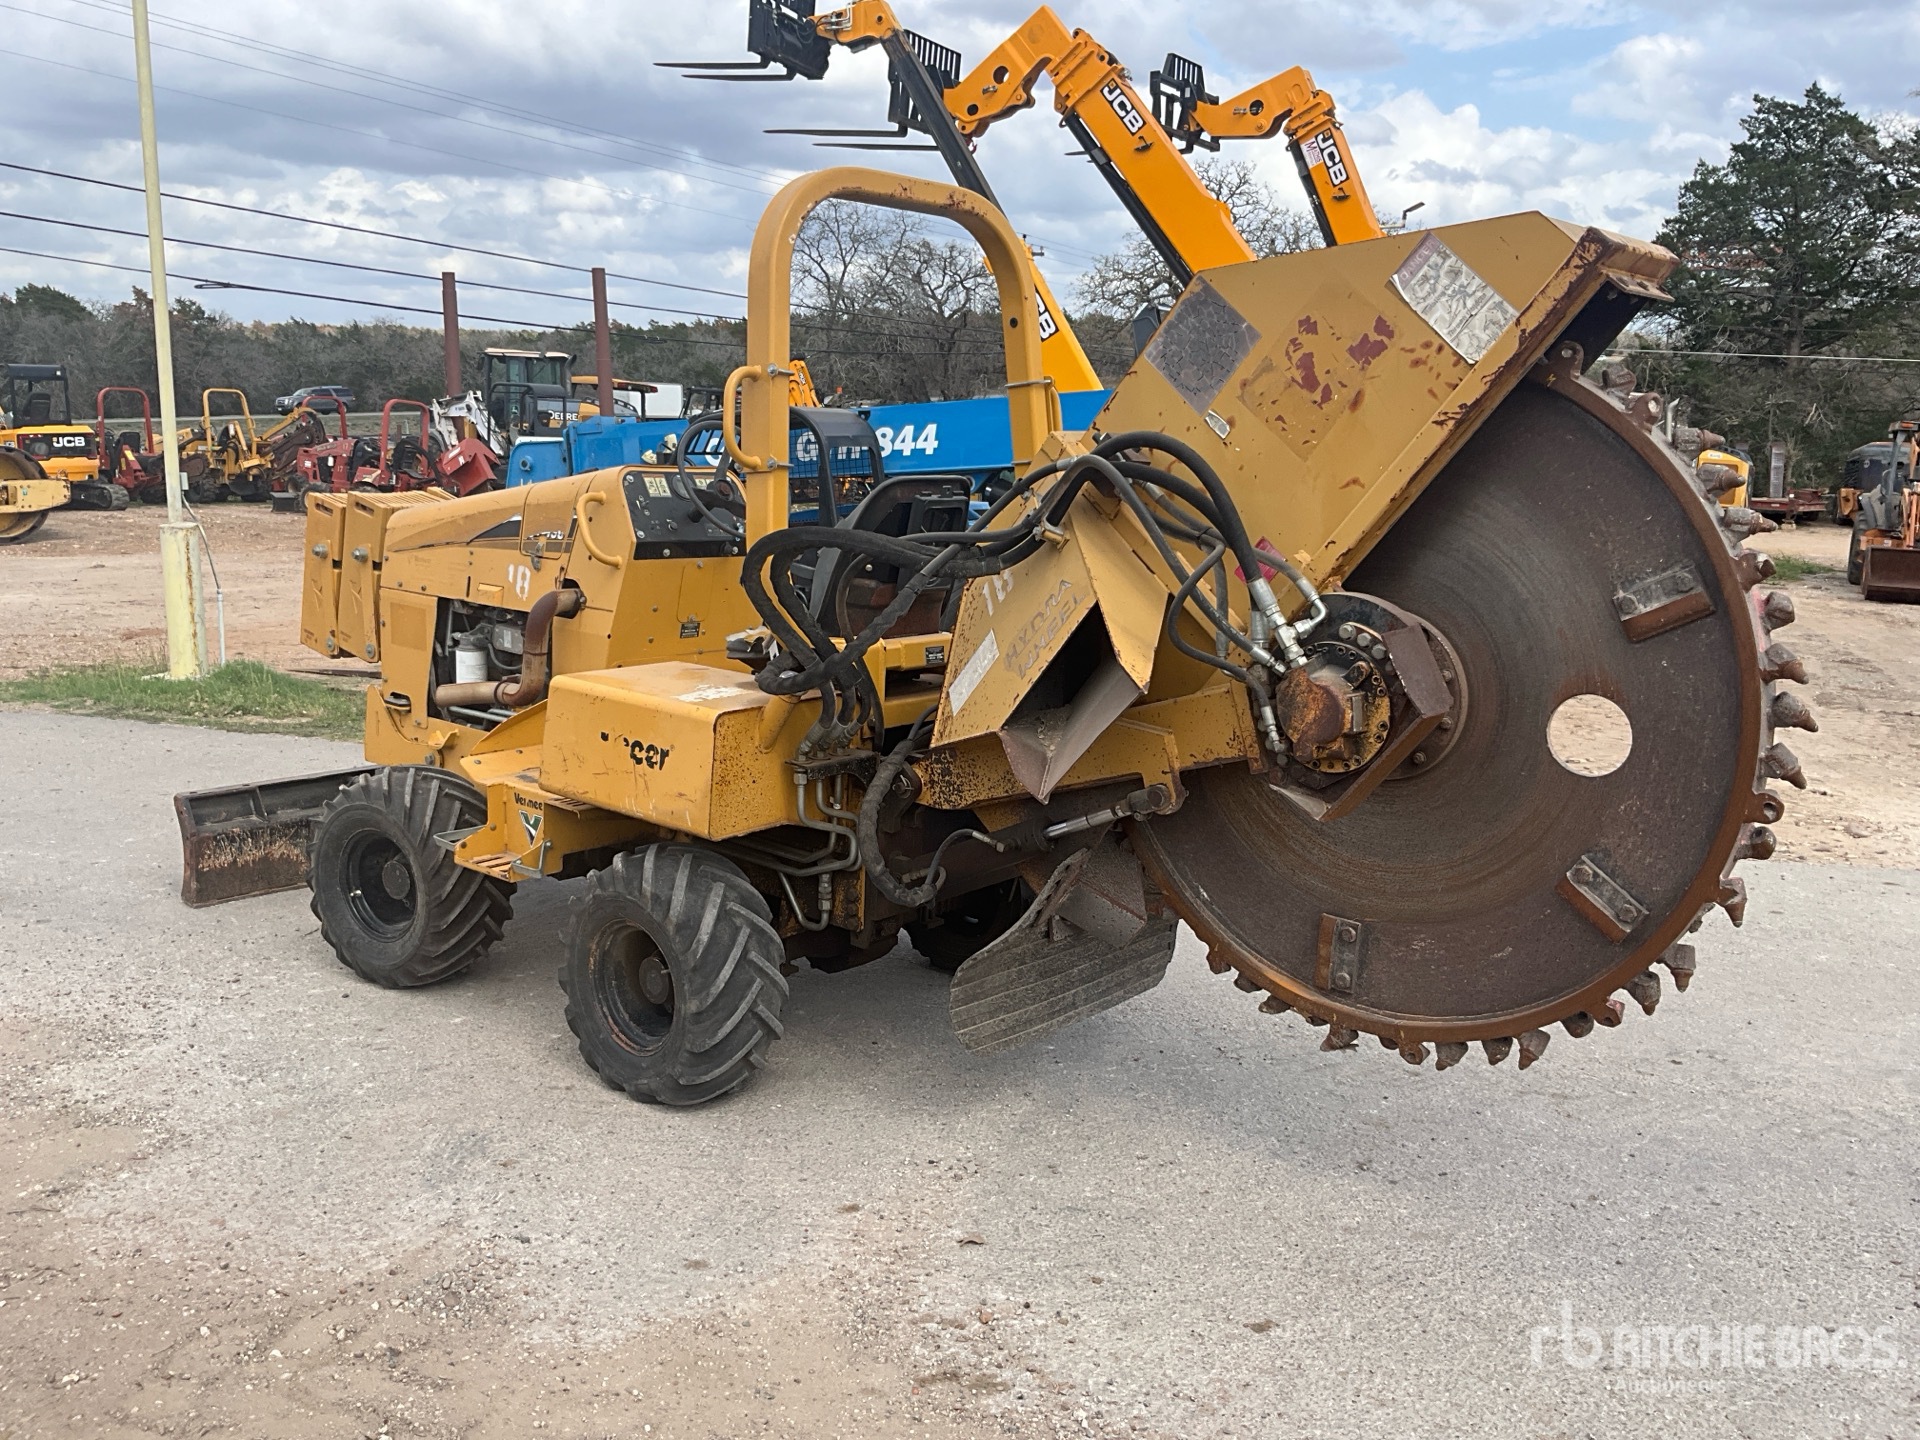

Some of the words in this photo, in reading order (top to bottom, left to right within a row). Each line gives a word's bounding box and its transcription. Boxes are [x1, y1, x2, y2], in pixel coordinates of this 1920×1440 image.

[1102, 82, 1144, 133] JCB
[1317, 130, 1347, 186] JCB
[52, 437, 86, 447] JCB
